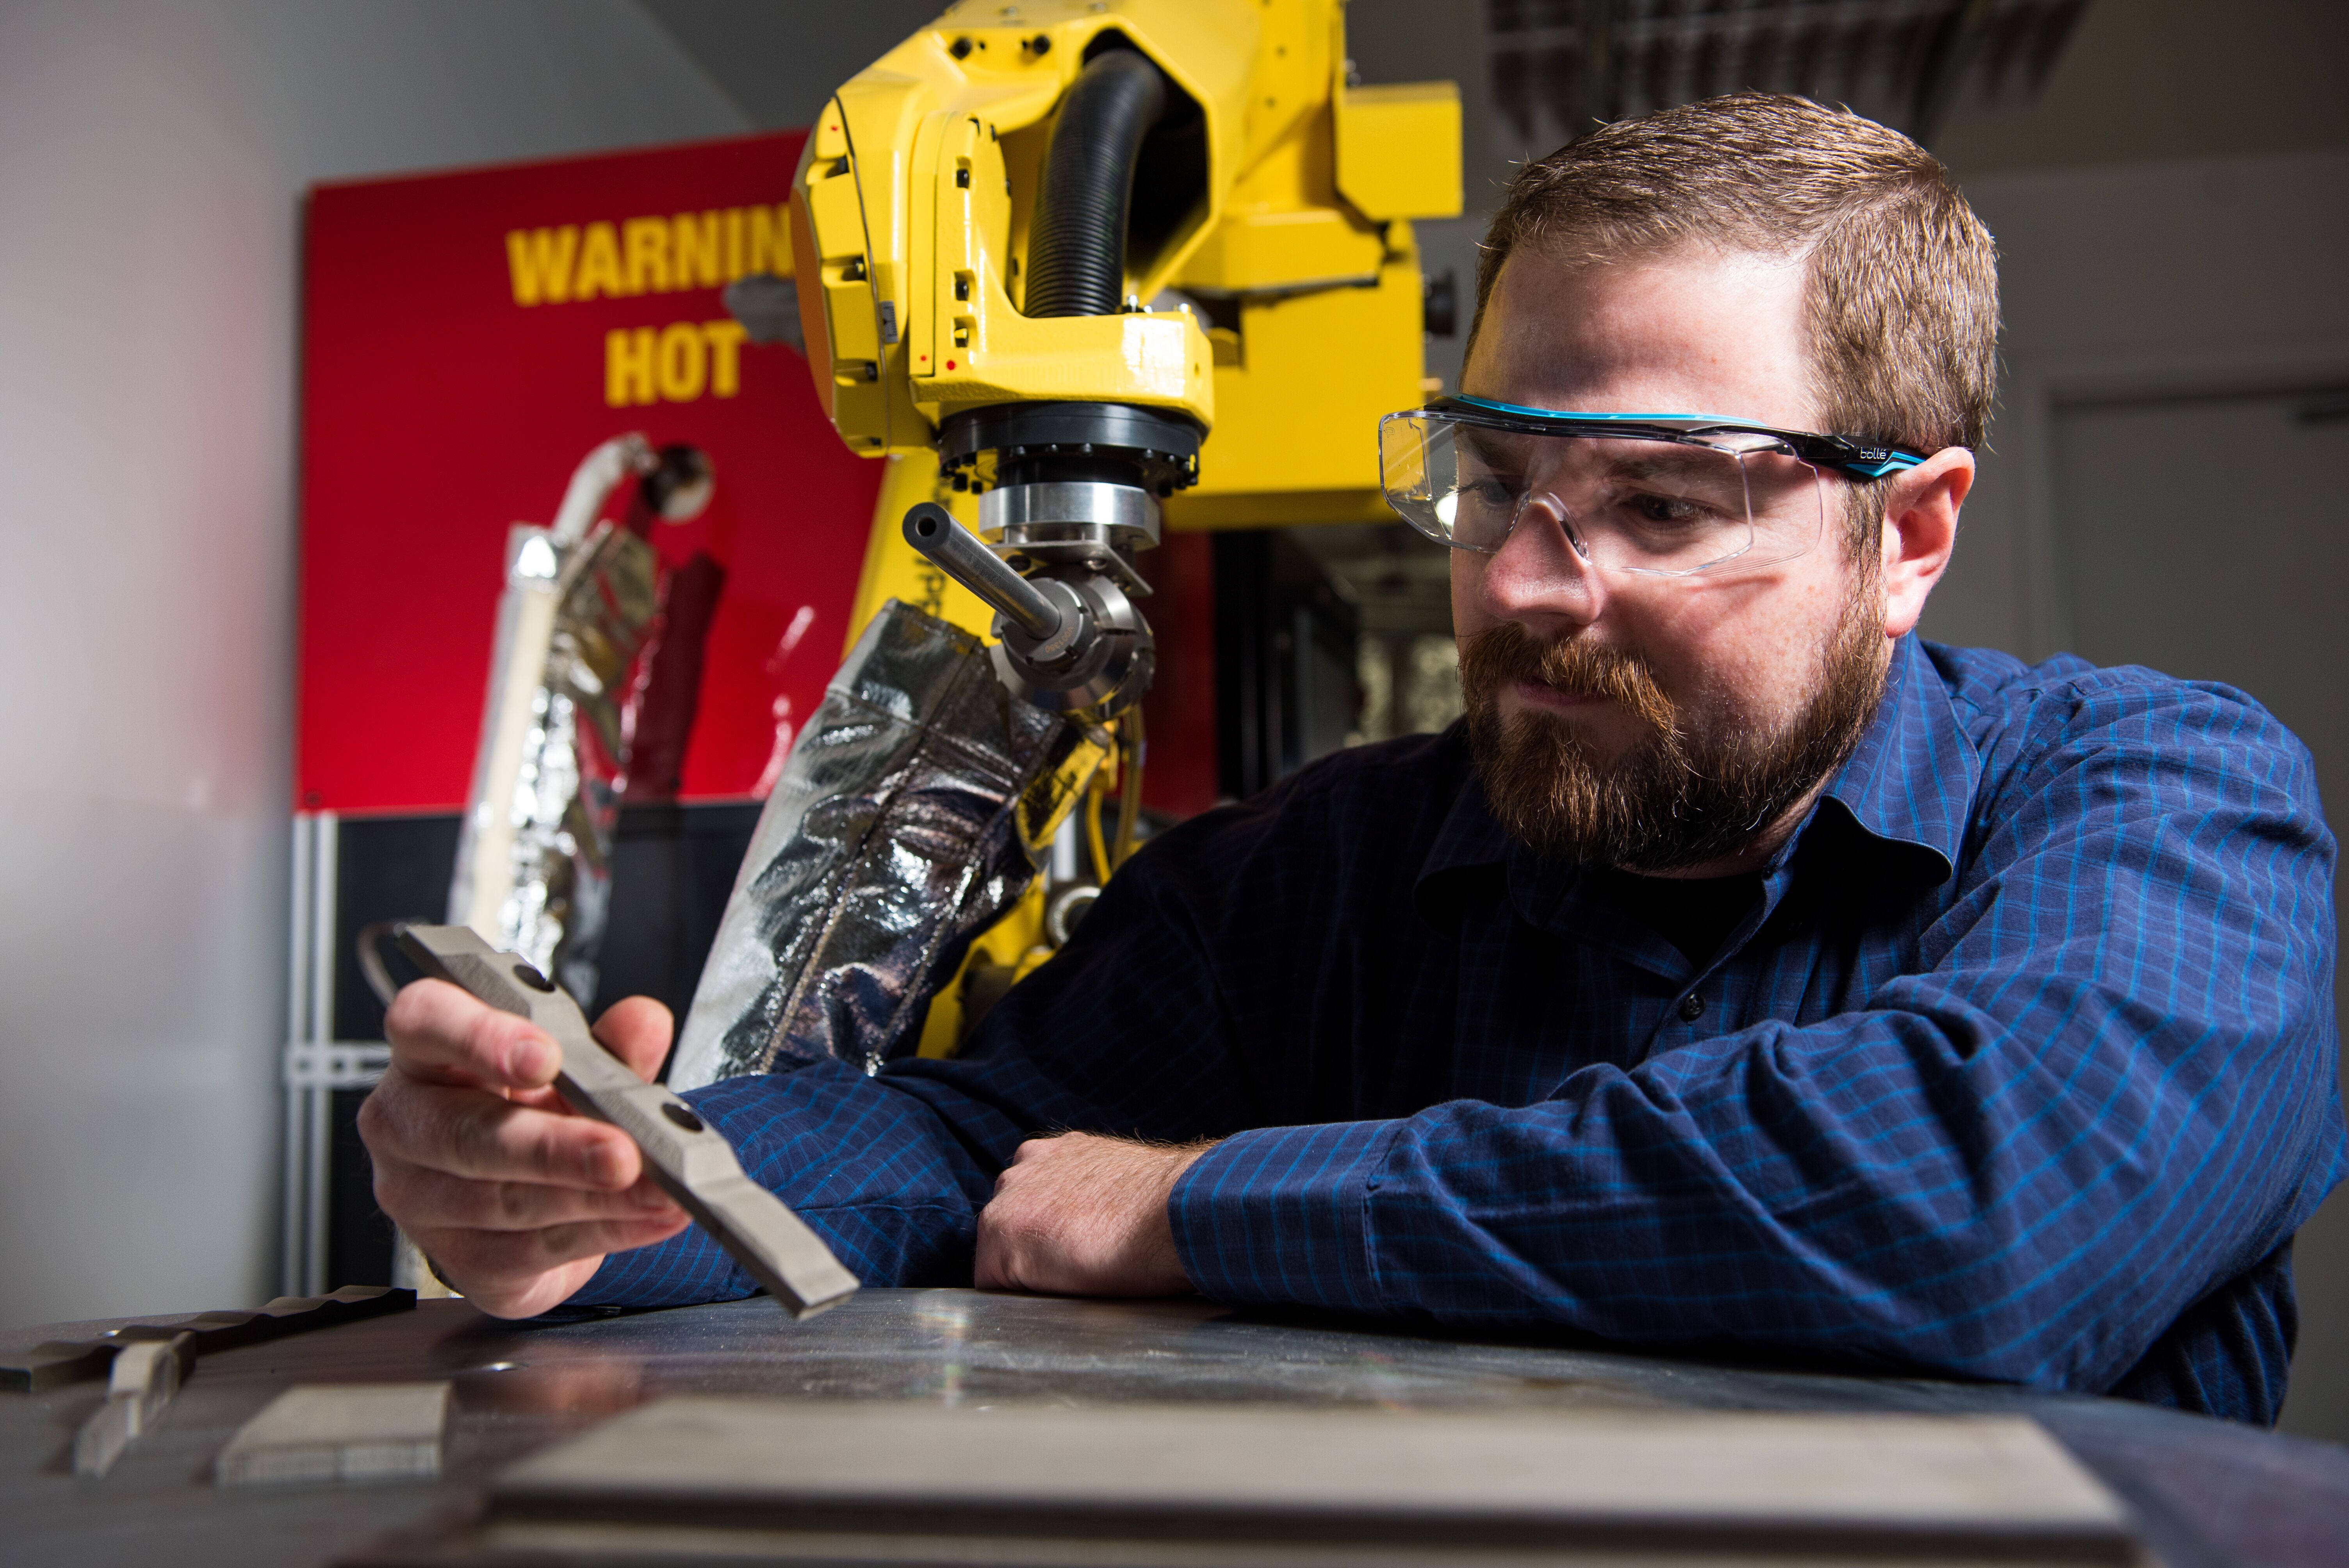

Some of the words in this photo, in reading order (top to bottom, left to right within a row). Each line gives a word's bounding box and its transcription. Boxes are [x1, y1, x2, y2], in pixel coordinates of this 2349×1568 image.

[506, 203, 795, 306] WARNIN
[604, 319, 748, 408] HOT
[1860, 447, 1887, 460] bollé
